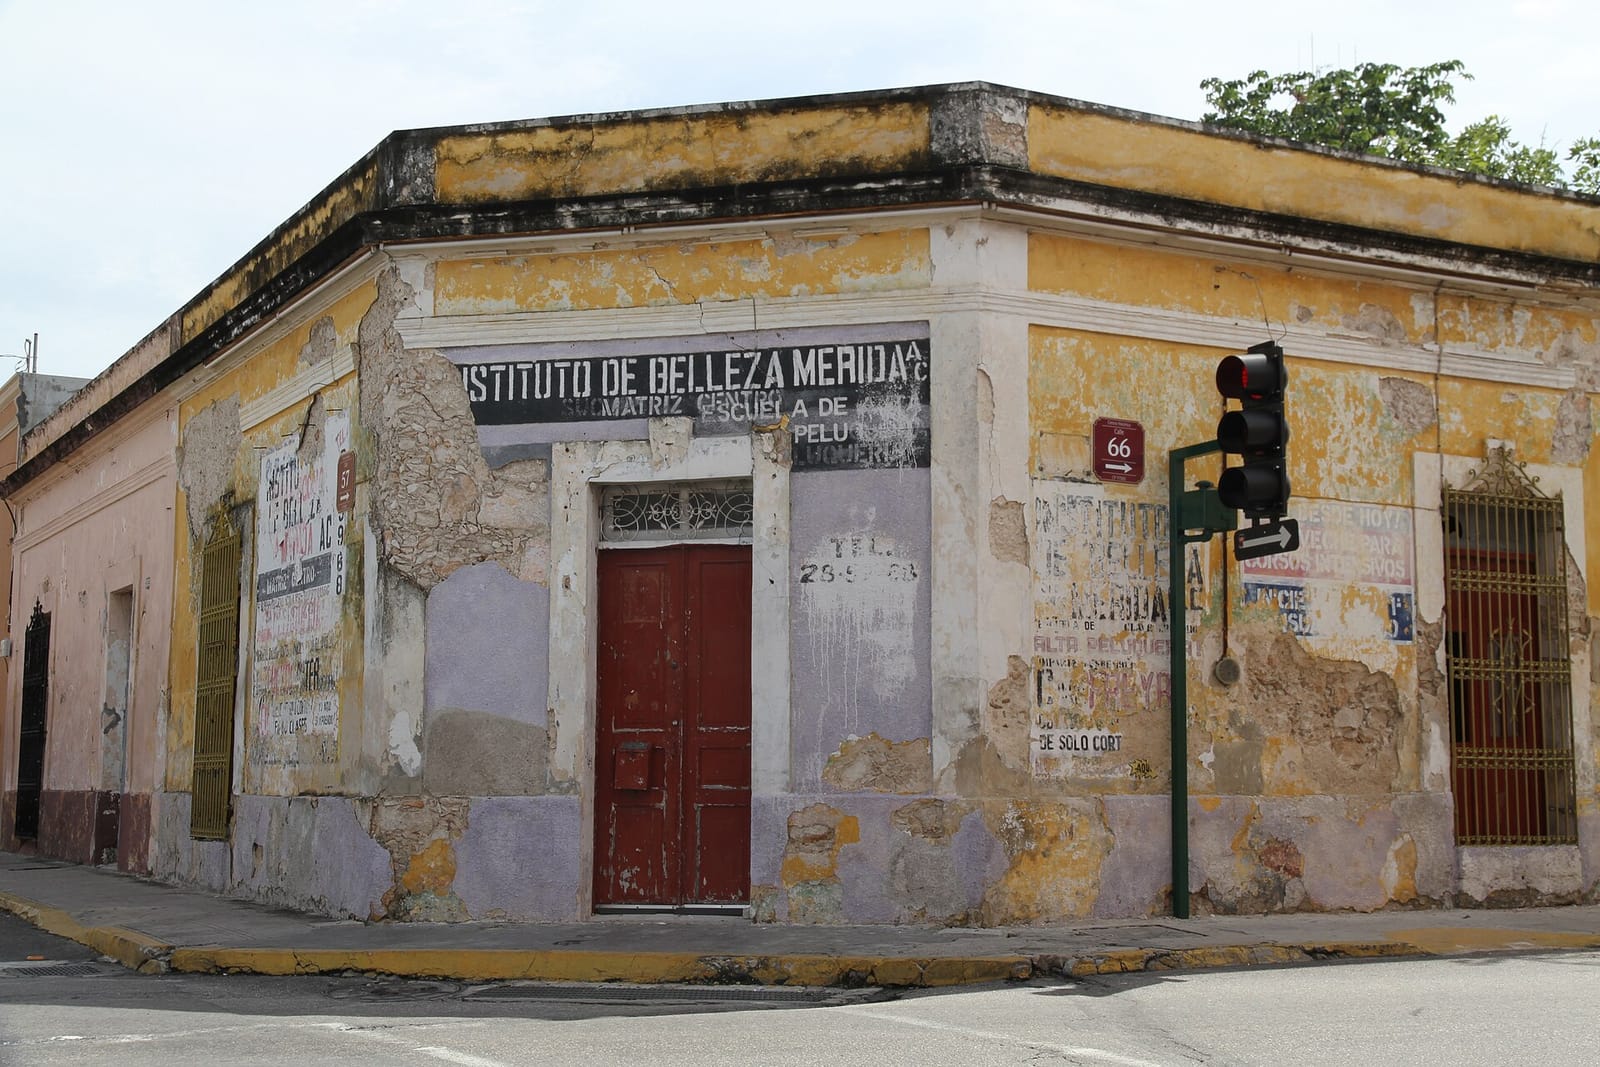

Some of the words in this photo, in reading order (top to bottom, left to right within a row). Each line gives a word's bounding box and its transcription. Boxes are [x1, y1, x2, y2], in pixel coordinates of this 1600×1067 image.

[602, 358, 638, 397] DE
[650, 350, 785, 394] BELLEZA
[793, 343, 907, 387] MERIDA
[601, 394, 683, 417] MATRIZ
[818, 396, 848, 417] DE
[1107, 437, 1131, 457] 66
[341, 469, 350, 489] 57
[1360, 508, 1401, 529] HOY!
[319, 513, 332, 551] AC
[1084, 621, 1096, 632] DE
[1033, 636, 1079, 653] ALTA
[1039, 734, 1055, 750] DE
[1059, 734, 1089, 751] SOLO
